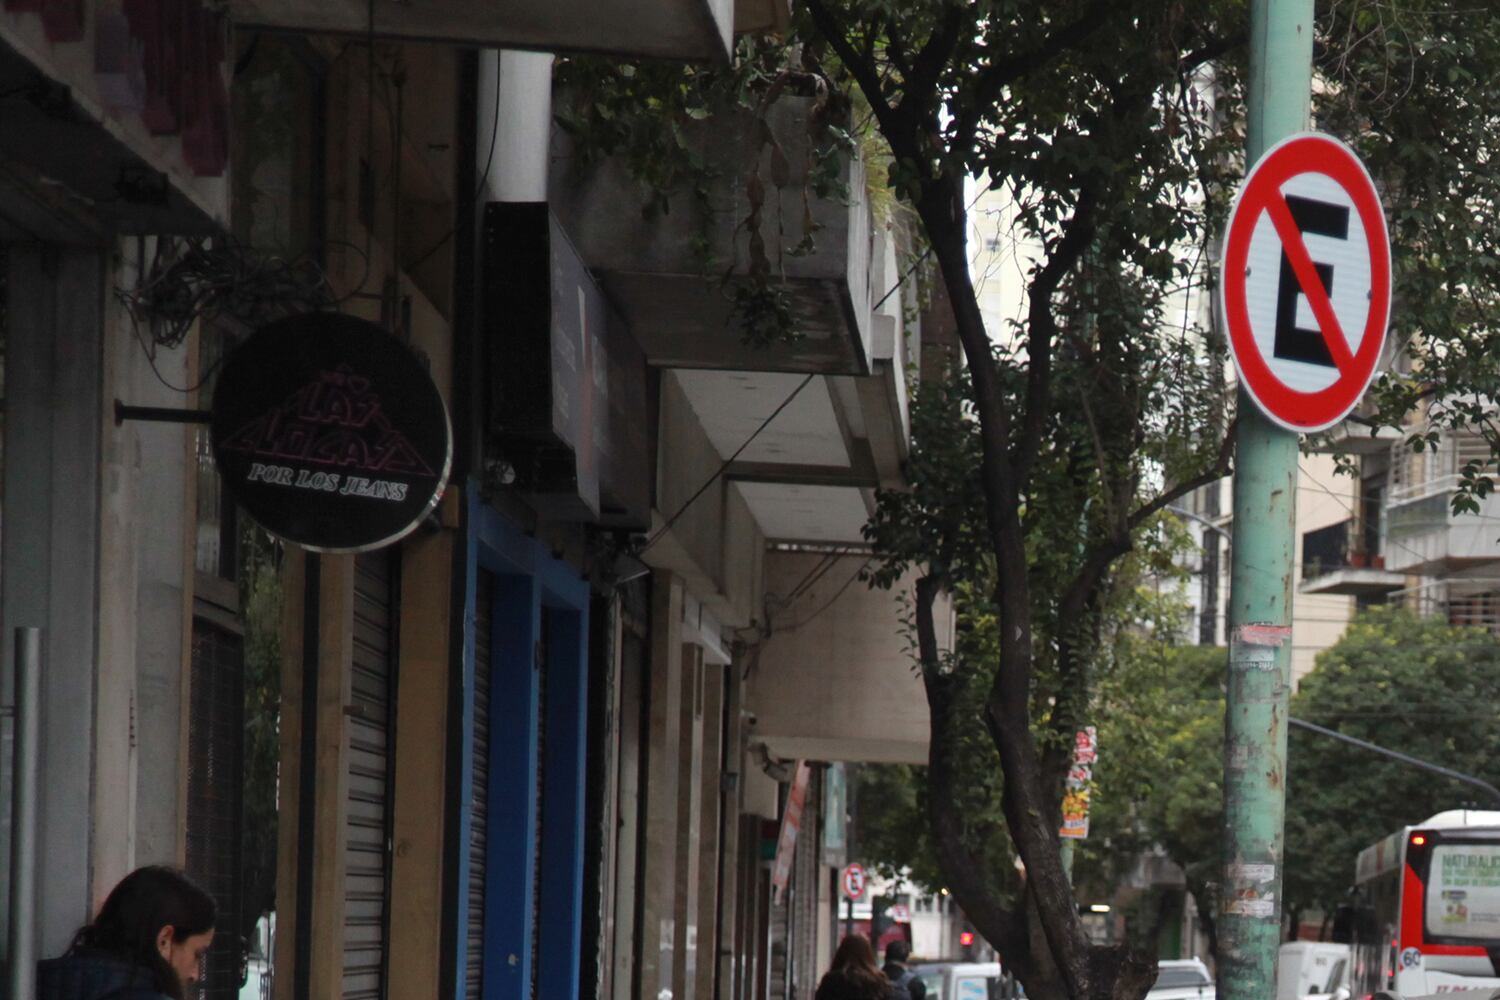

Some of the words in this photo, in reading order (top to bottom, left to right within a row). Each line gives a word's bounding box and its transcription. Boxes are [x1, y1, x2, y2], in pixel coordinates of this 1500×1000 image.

[1274, 193, 1350, 369] E
[248, 462, 292, 487] POR
[295, 469, 340, 492] LOS
[339, 476, 408, 502] JEANS
